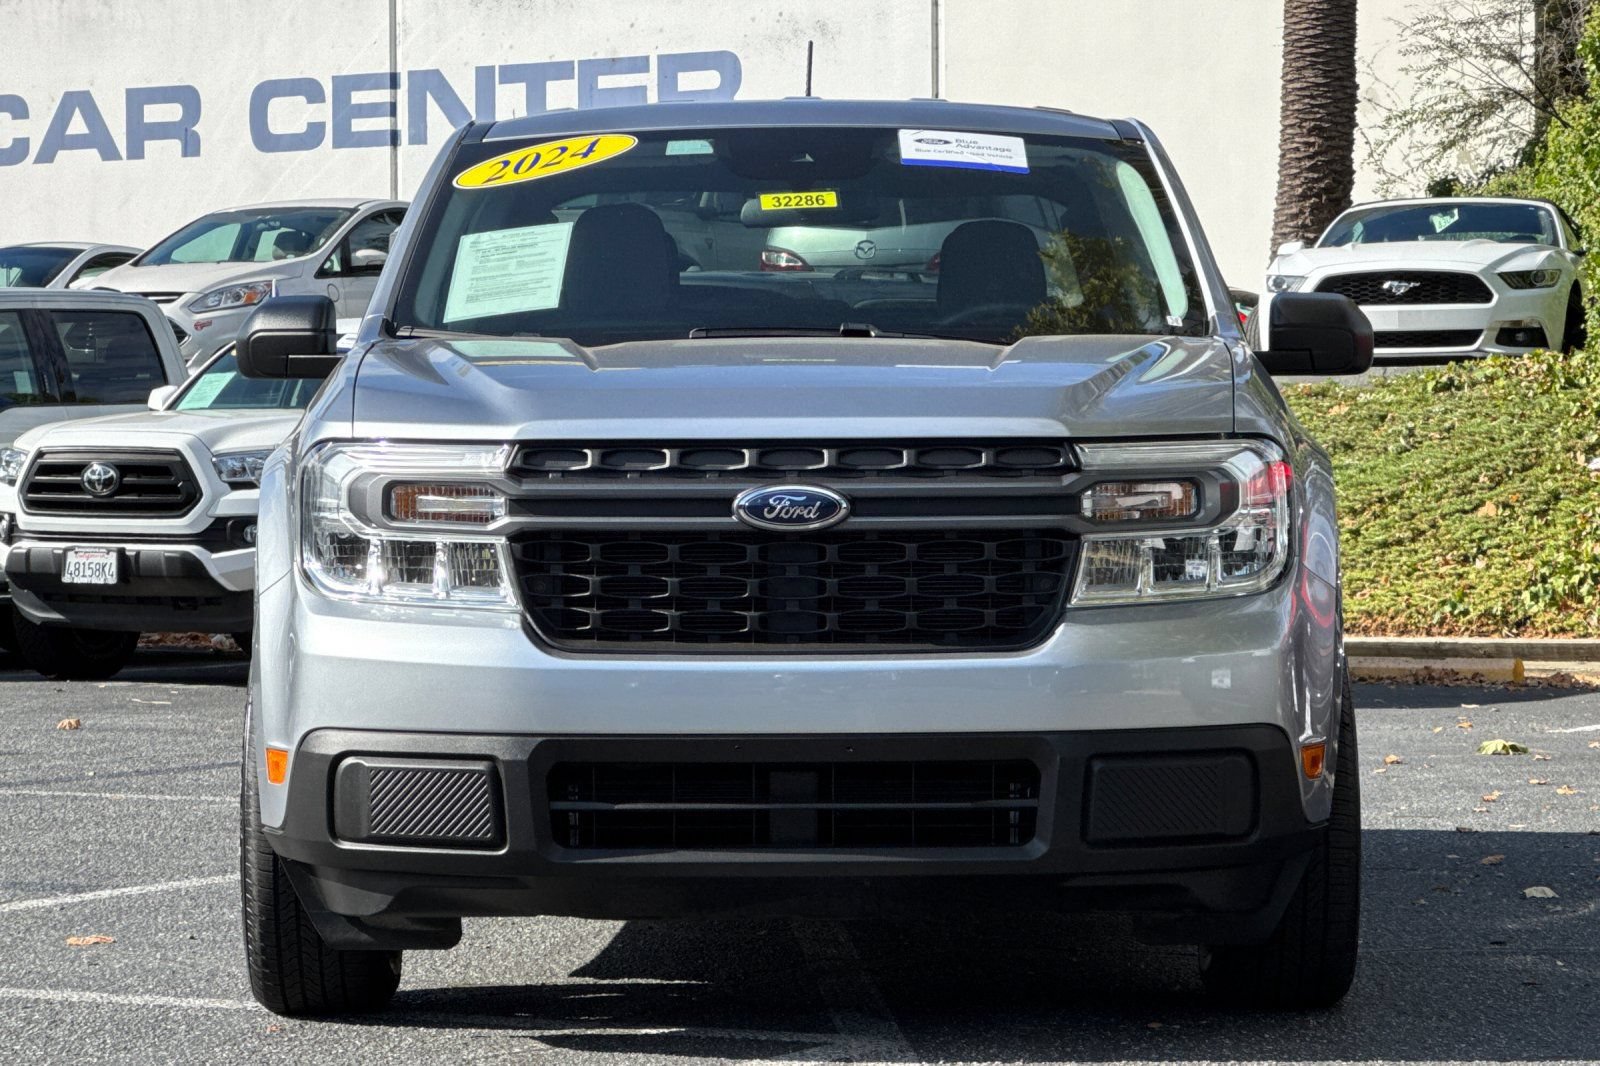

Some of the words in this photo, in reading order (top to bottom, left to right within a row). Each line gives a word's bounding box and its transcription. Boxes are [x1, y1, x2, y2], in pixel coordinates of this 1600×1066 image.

[956, 143, 1012, 153] Advantage
[482, 138, 600, 185] 2024
[771, 194, 826, 208] 32286
[763, 494, 821, 519] Ford
[67, 561, 114, 578] 48158K4
